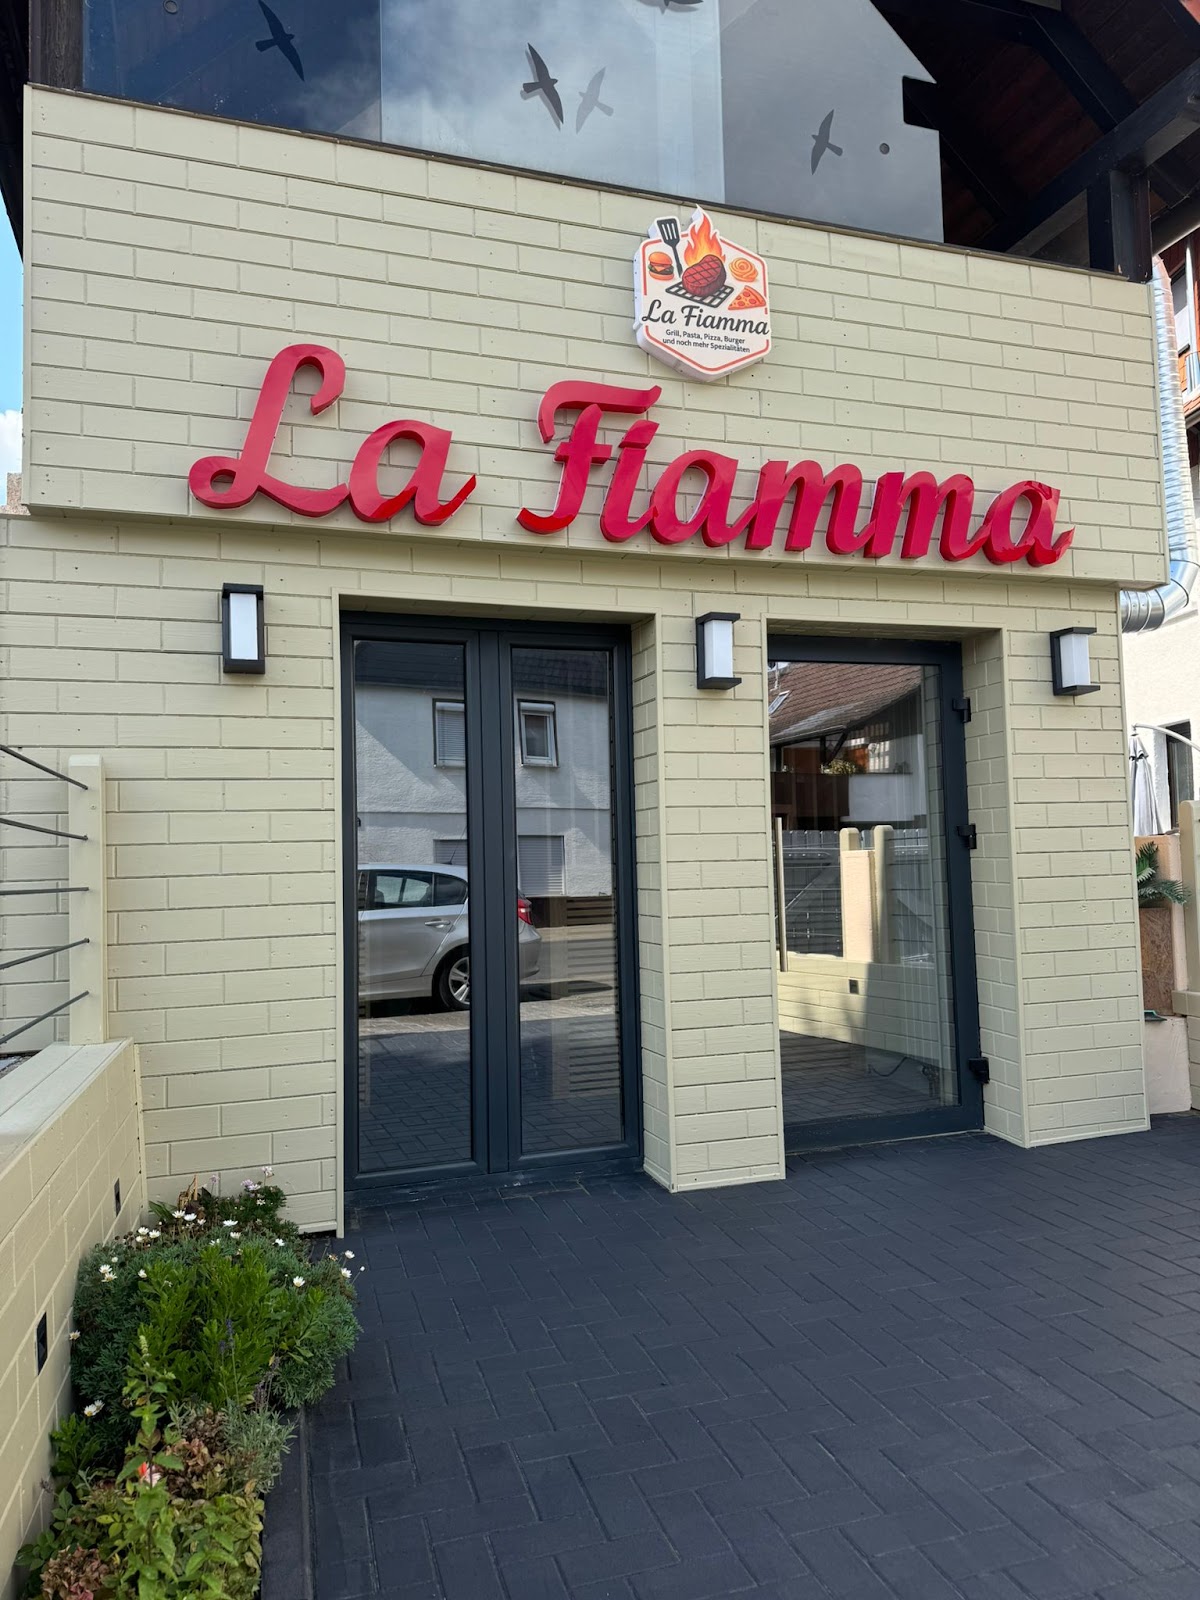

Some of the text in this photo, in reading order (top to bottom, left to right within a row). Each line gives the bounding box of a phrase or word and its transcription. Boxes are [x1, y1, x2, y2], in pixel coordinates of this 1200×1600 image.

[641, 299, 769, 335] La Fiamma
[663, 338, 675, 346] und
[676, 339, 692, 347] noch
[710, 342, 751, 353] Spezialitäten
[665, 329, 745, 344] Grill, Pasta, Pizza, Burger
[188, 343, 1075, 567] La Fiamma
